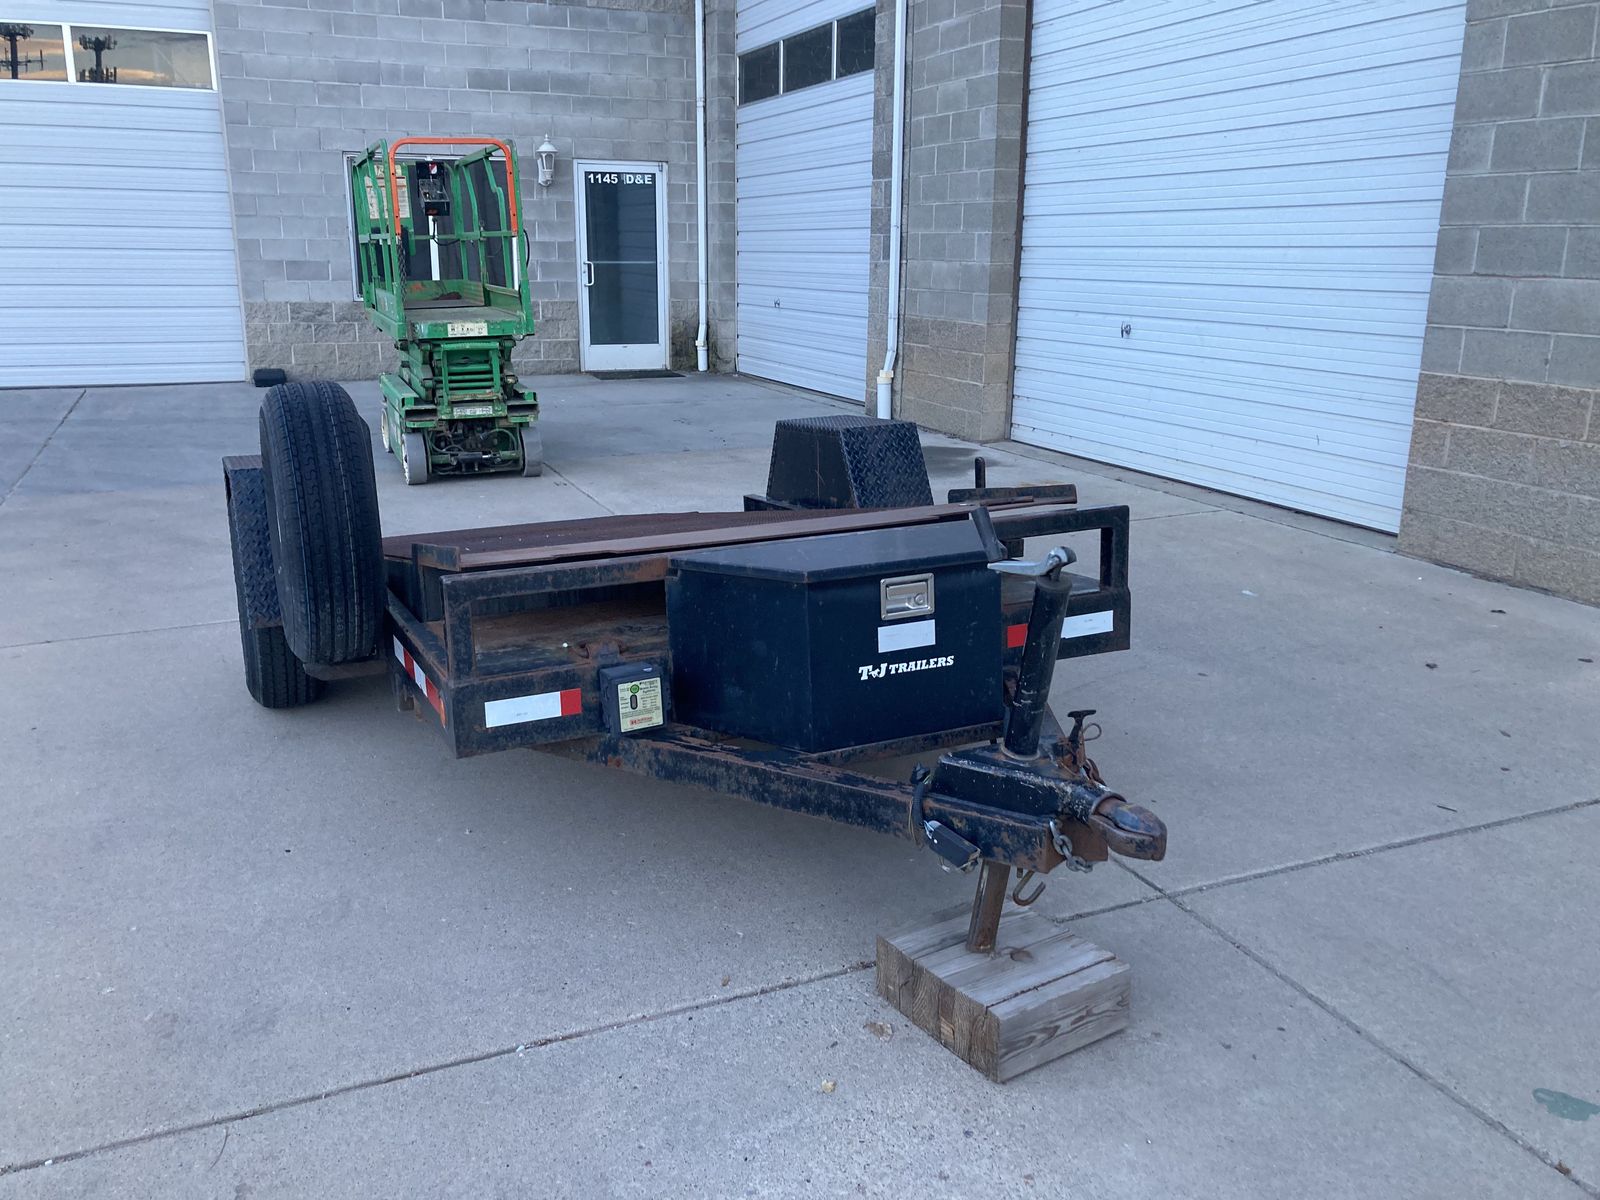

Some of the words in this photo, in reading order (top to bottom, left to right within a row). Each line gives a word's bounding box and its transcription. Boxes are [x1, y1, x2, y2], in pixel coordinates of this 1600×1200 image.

[588, 173, 618, 184] 1145
[626, 174, 653, 185] D&E
[888, 655, 955, 675] TRAILERS
